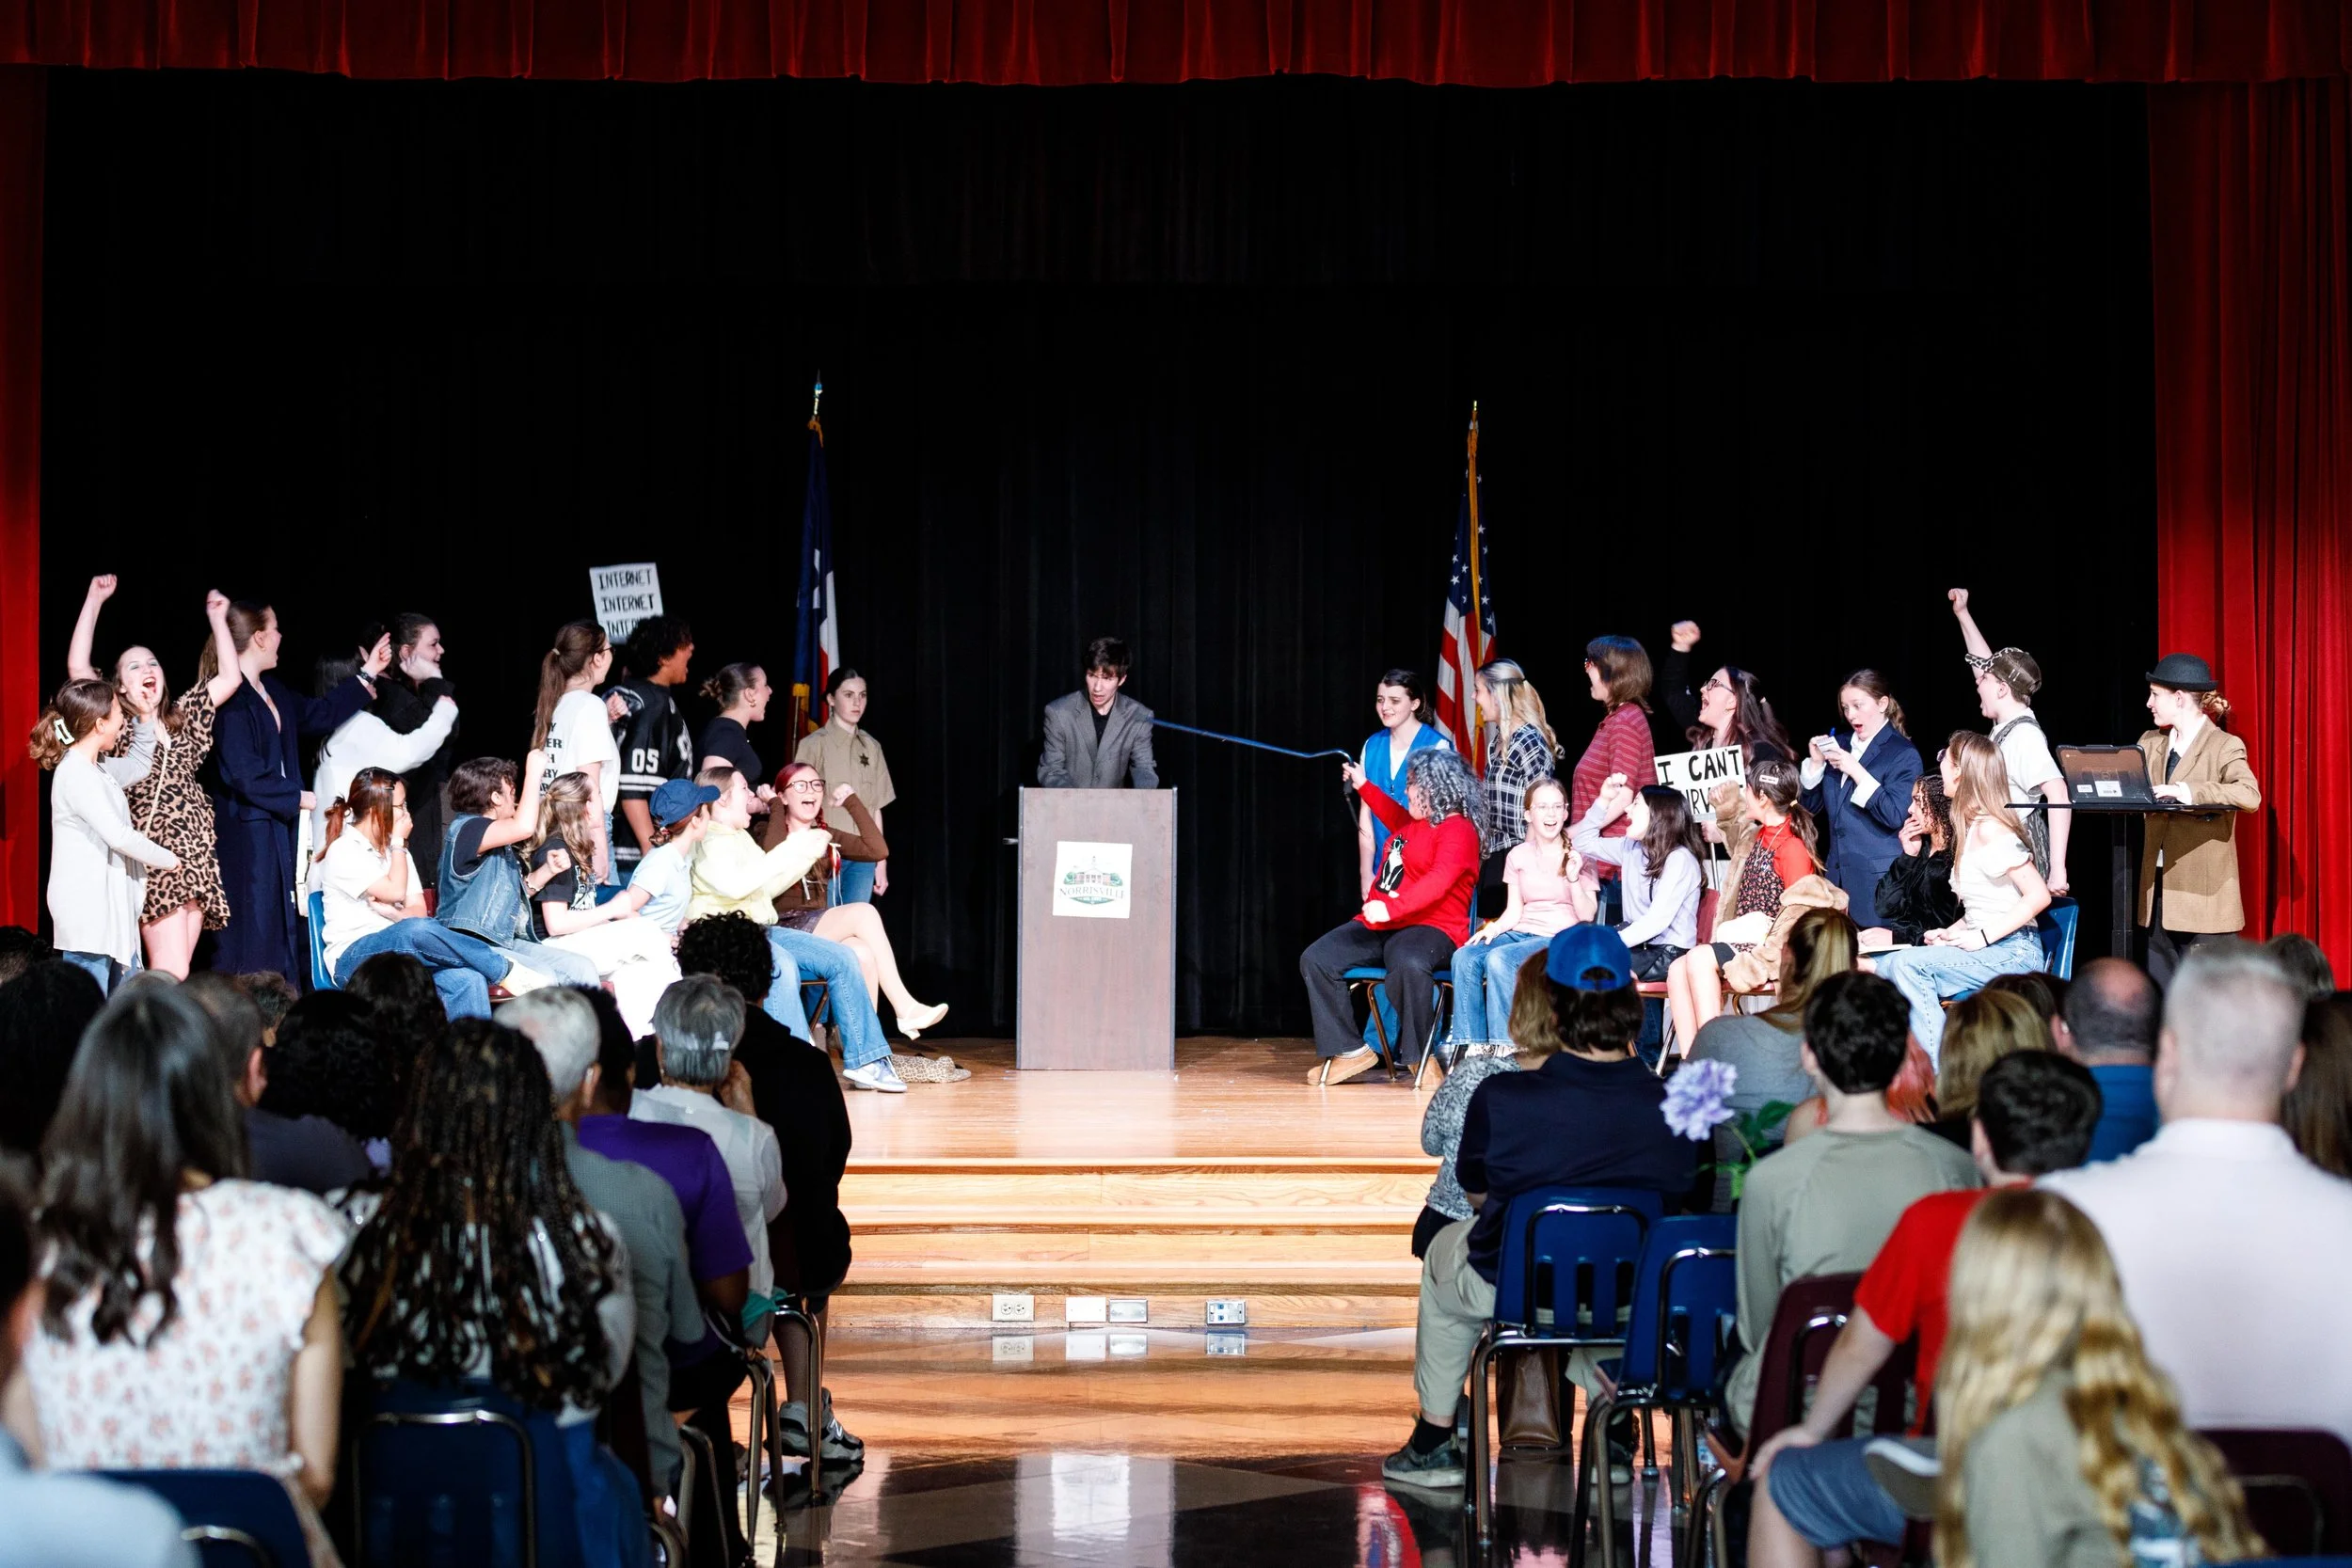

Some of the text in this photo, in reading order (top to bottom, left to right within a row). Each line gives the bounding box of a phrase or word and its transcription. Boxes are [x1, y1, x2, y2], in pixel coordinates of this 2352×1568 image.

[598, 569, 651, 590] INTERNET
[602, 594, 654, 612] INTERNET
[631, 748, 659, 773] 05
[1658, 749, 1739, 785] I CAN'T
[1059, 886, 1123, 899] NORRISVILLE
